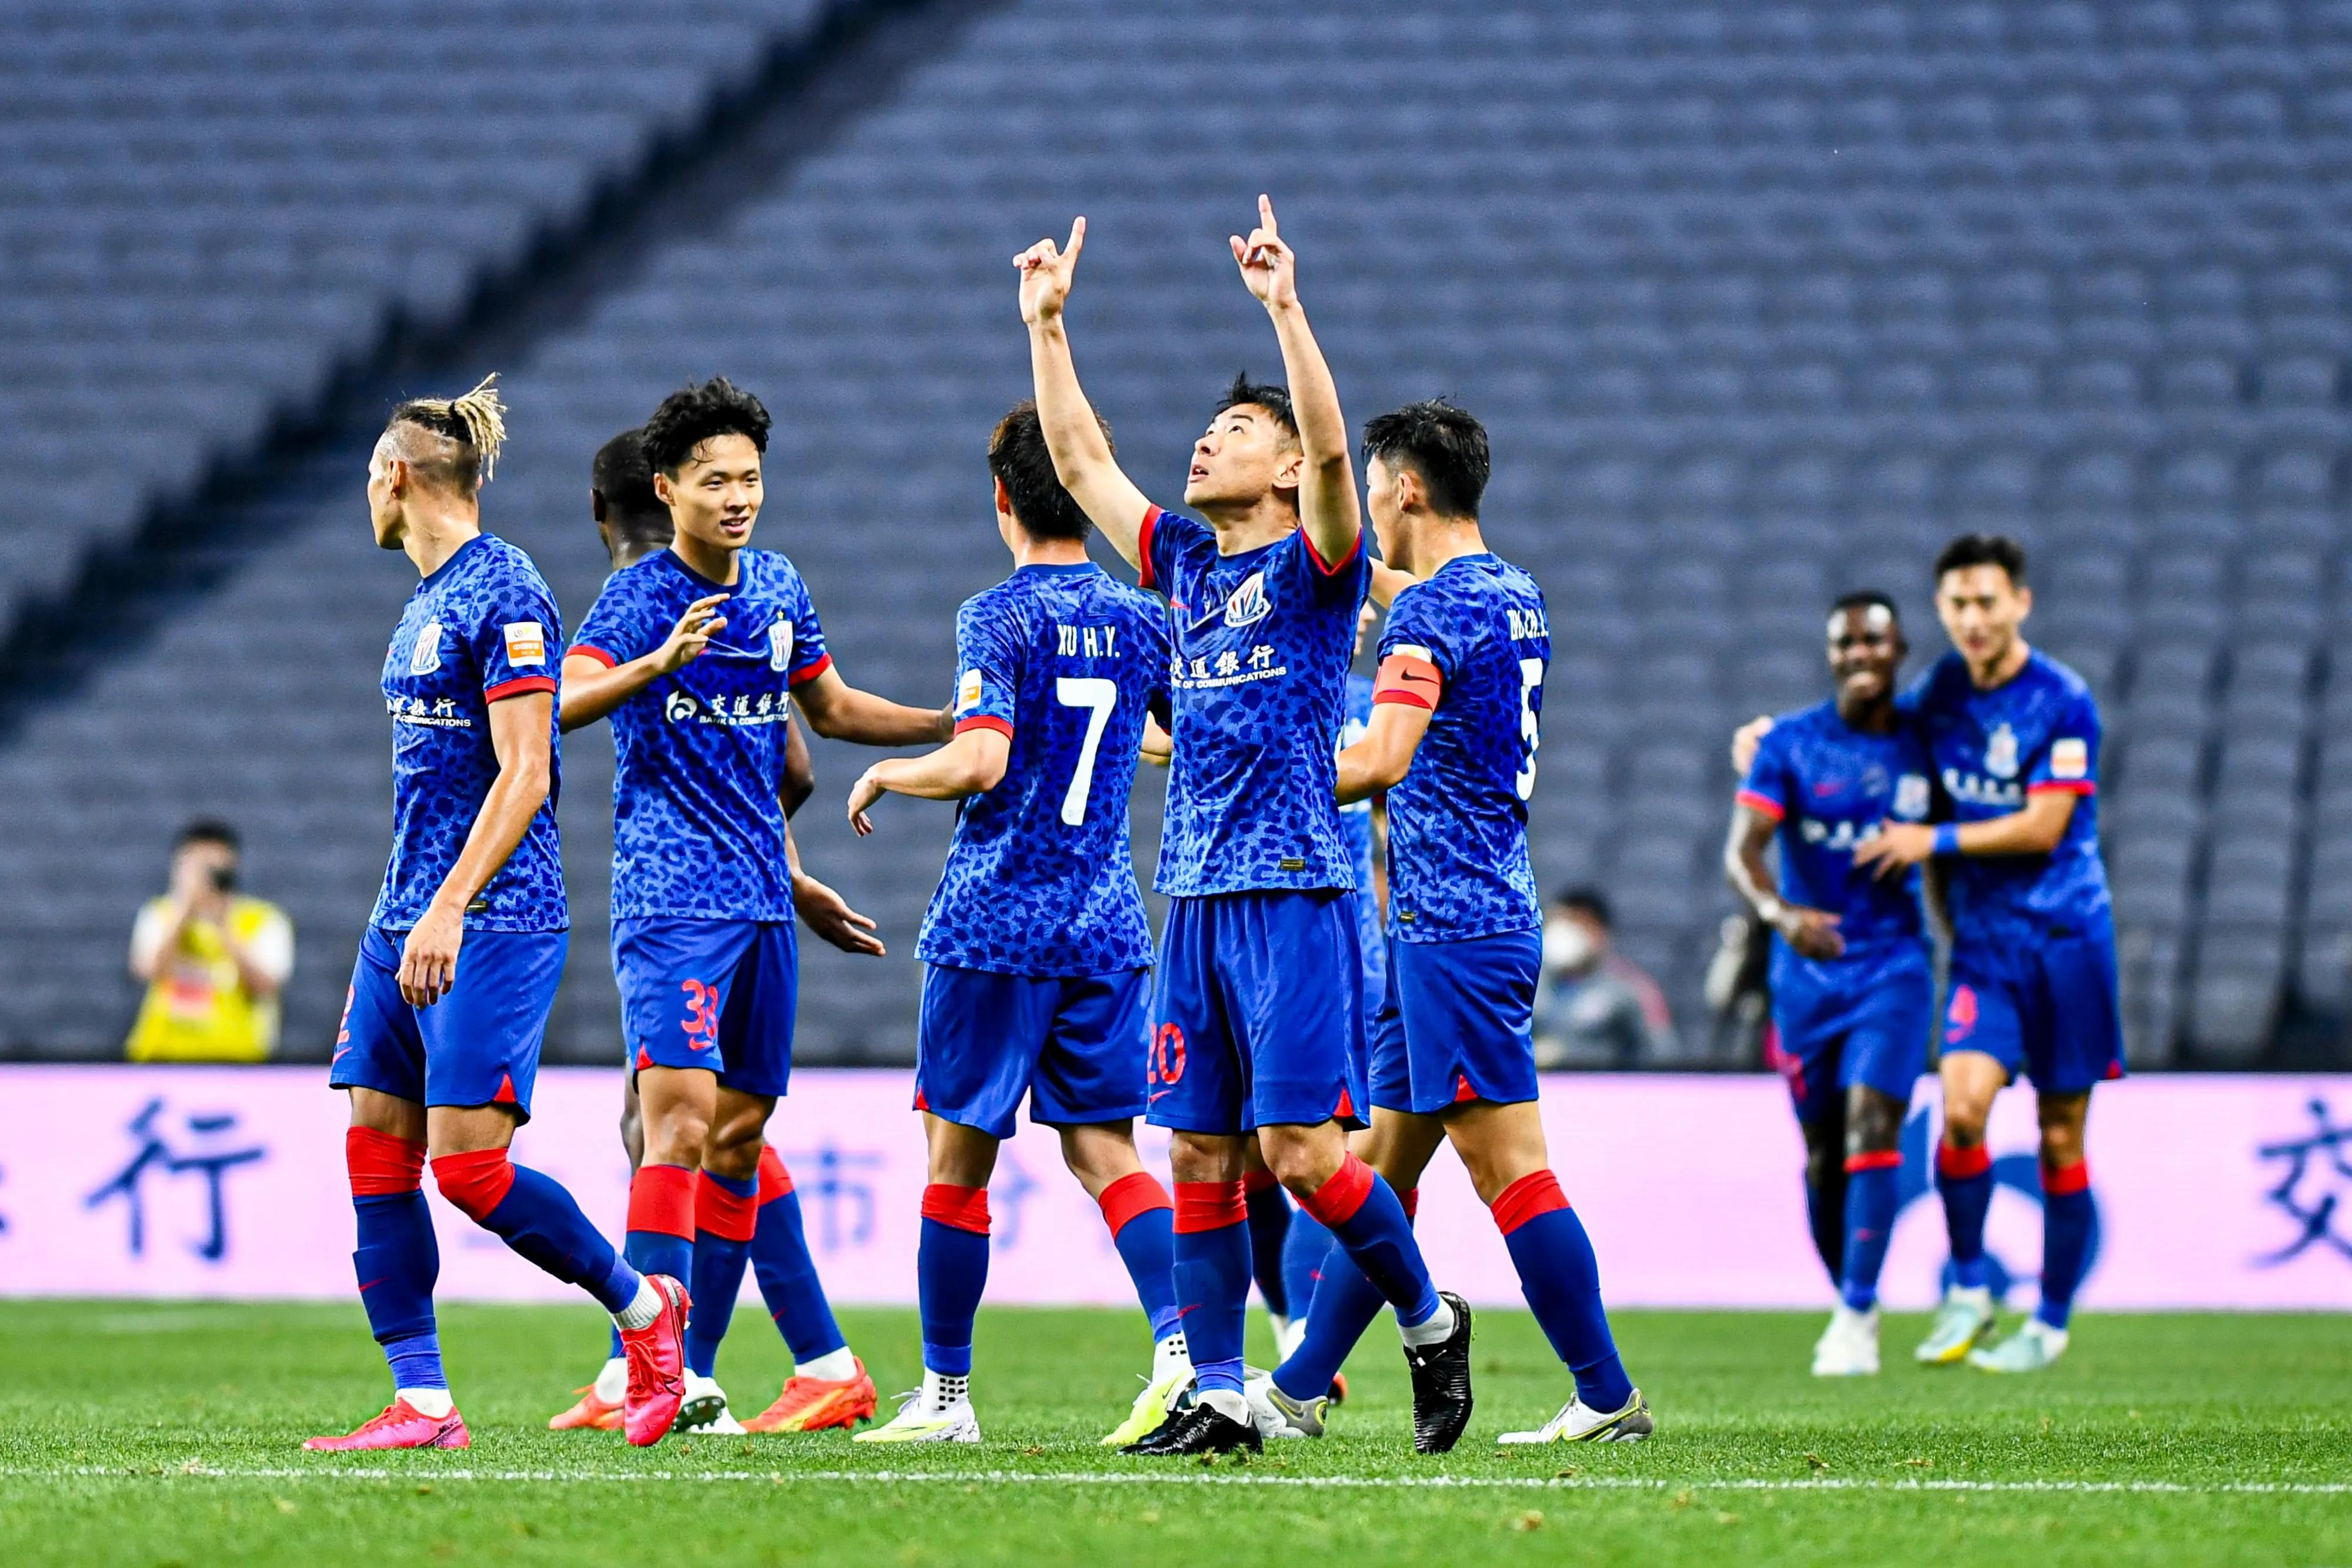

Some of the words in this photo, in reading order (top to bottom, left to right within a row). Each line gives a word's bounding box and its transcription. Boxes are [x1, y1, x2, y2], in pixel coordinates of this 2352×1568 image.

[1057, 624, 1077, 657] XU
[1083, 626, 1120, 658] H.Y.
[1197, 666, 1287, 689] COMMUNICATIONS
[699, 716, 727, 726] BANK
[1516, 658, 1543, 801] 5
[1057, 678, 1117, 826] 7
